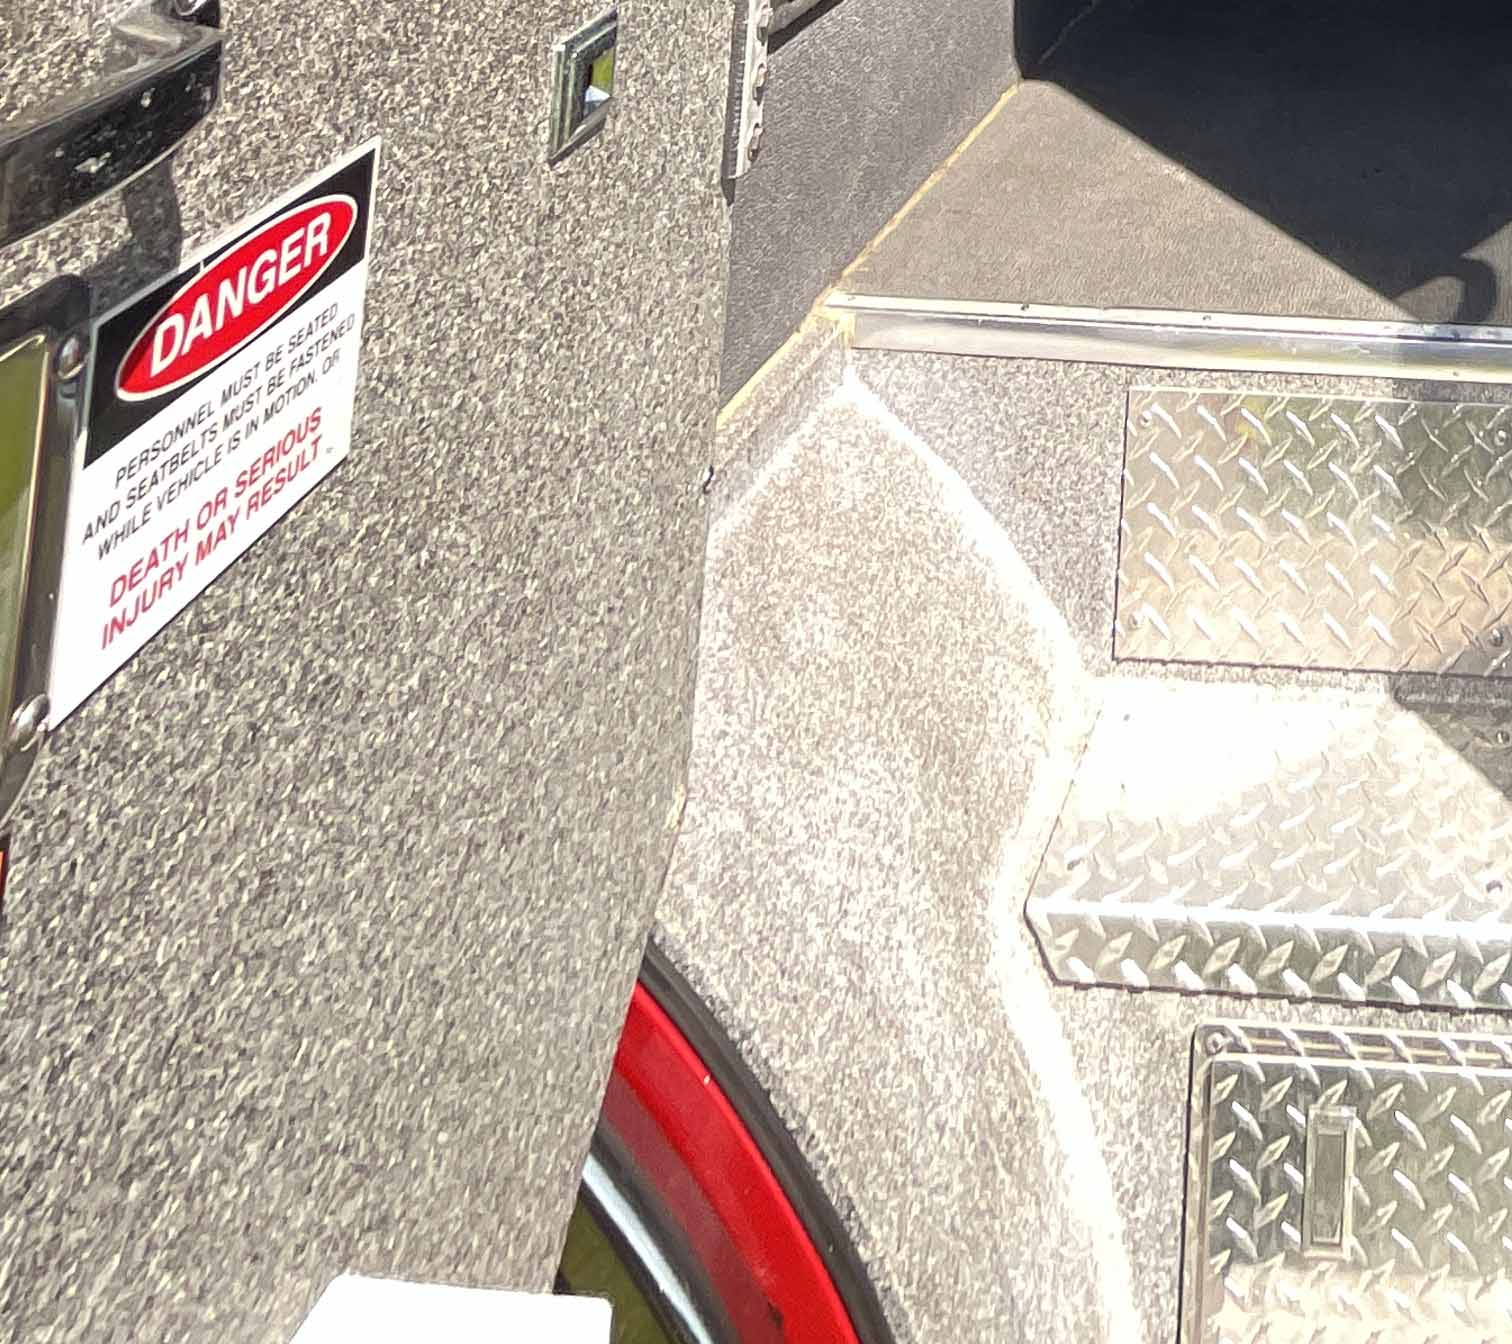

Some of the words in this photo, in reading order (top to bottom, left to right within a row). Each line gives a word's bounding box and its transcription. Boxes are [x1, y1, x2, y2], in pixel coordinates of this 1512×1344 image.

[115, 399, 215, 489] PERSONNEL
[221, 362, 260, 405] MUST
[265, 344, 283, 368] BE
[287, 302, 338, 349] SEATED
[150, 210, 332, 378] DANGER
[83, 500, 121, 543] AND
[126, 422, 218, 509] SEATBELTS
[222, 387, 262, 431] MUST
[266, 368, 285, 396] BE
[288, 313, 355, 376] FASTENED
[97, 503, 153, 560] WHILE
[156, 444, 223, 511] VEHICLE
[227, 429, 241, 454] IS
[245, 414, 259, 440] IN
[322, 349, 340, 375] OR
[109, 518, 189, 607] DEATH
[196, 486, 228, 530] OR
[235, 406, 322, 497] SERIOUS
[101, 555, 188, 649] INJURY
[194, 506, 240, 565] MAY
[246, 435, 321, 519] RESULT
